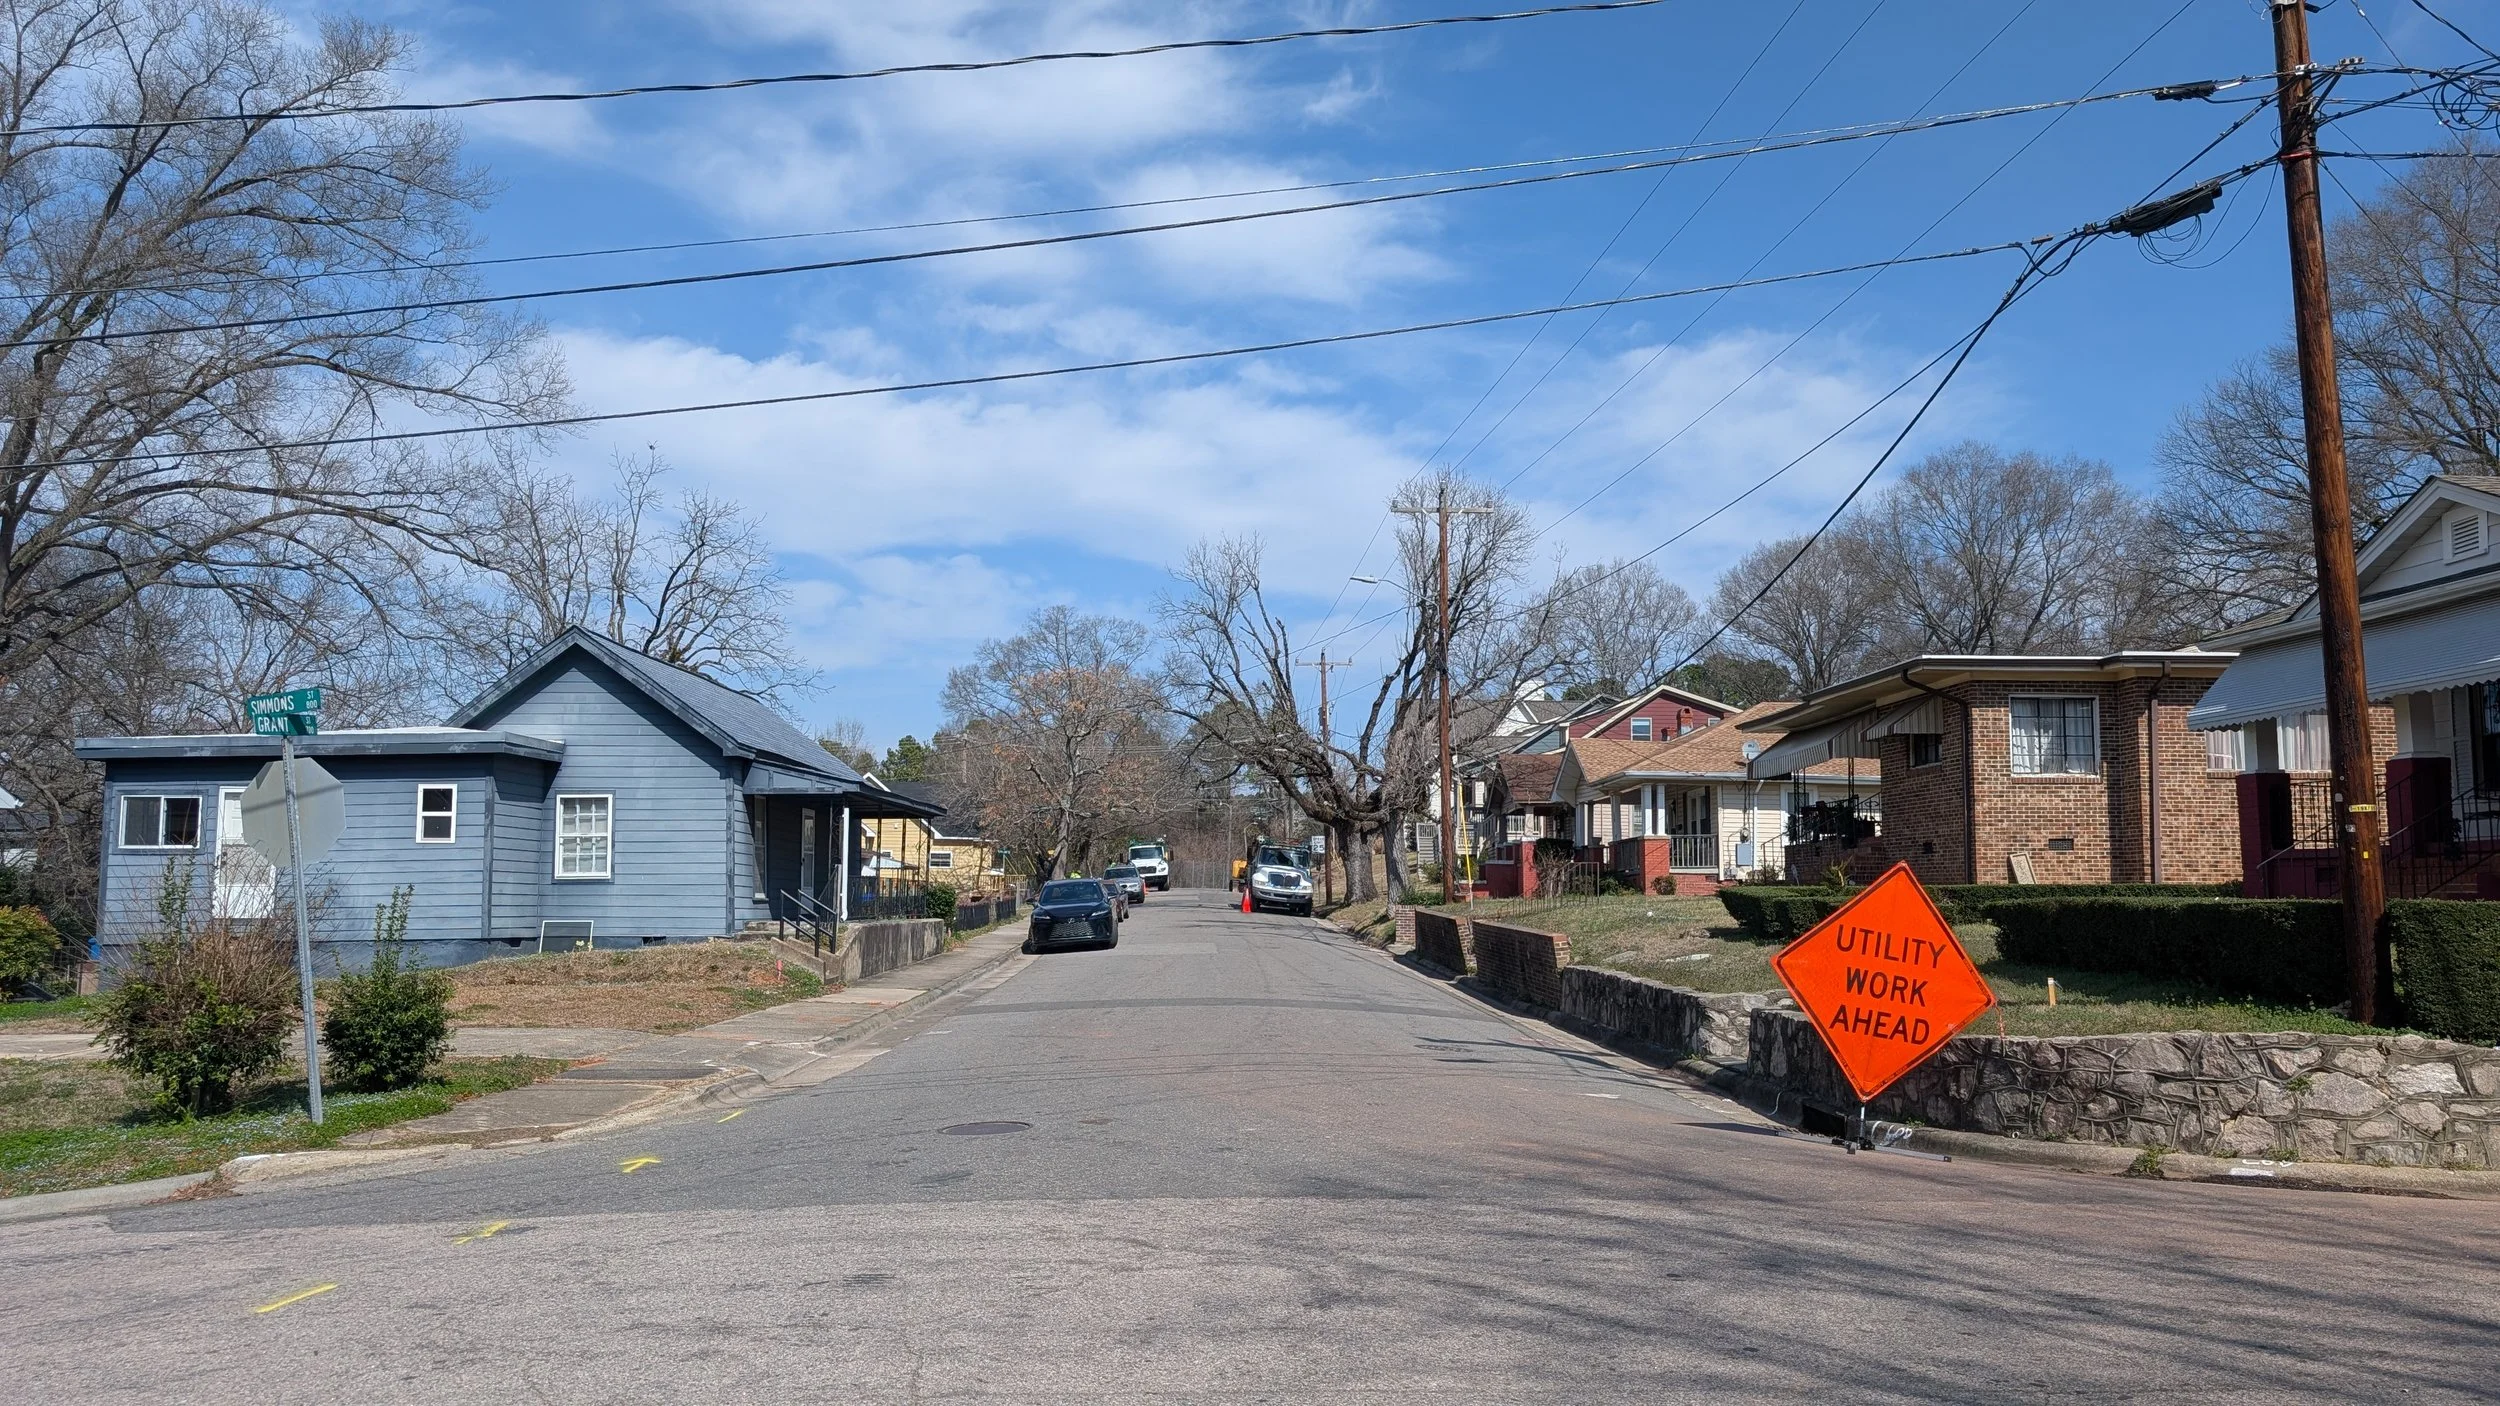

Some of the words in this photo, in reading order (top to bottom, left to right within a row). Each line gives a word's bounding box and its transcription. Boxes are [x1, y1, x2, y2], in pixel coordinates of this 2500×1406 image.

[251, 695, 294, 715] SIMMONS
[307, 690, 314, 699] ST
[306, 700, 317, 709] 800
[258, 717, 289, 732] GRANT
[1836, 924, 1947, 969] UTILITY
[1846, 966, 1929, 1007] WORK
[1829, 1004, 1930, 1046] AHEAD
